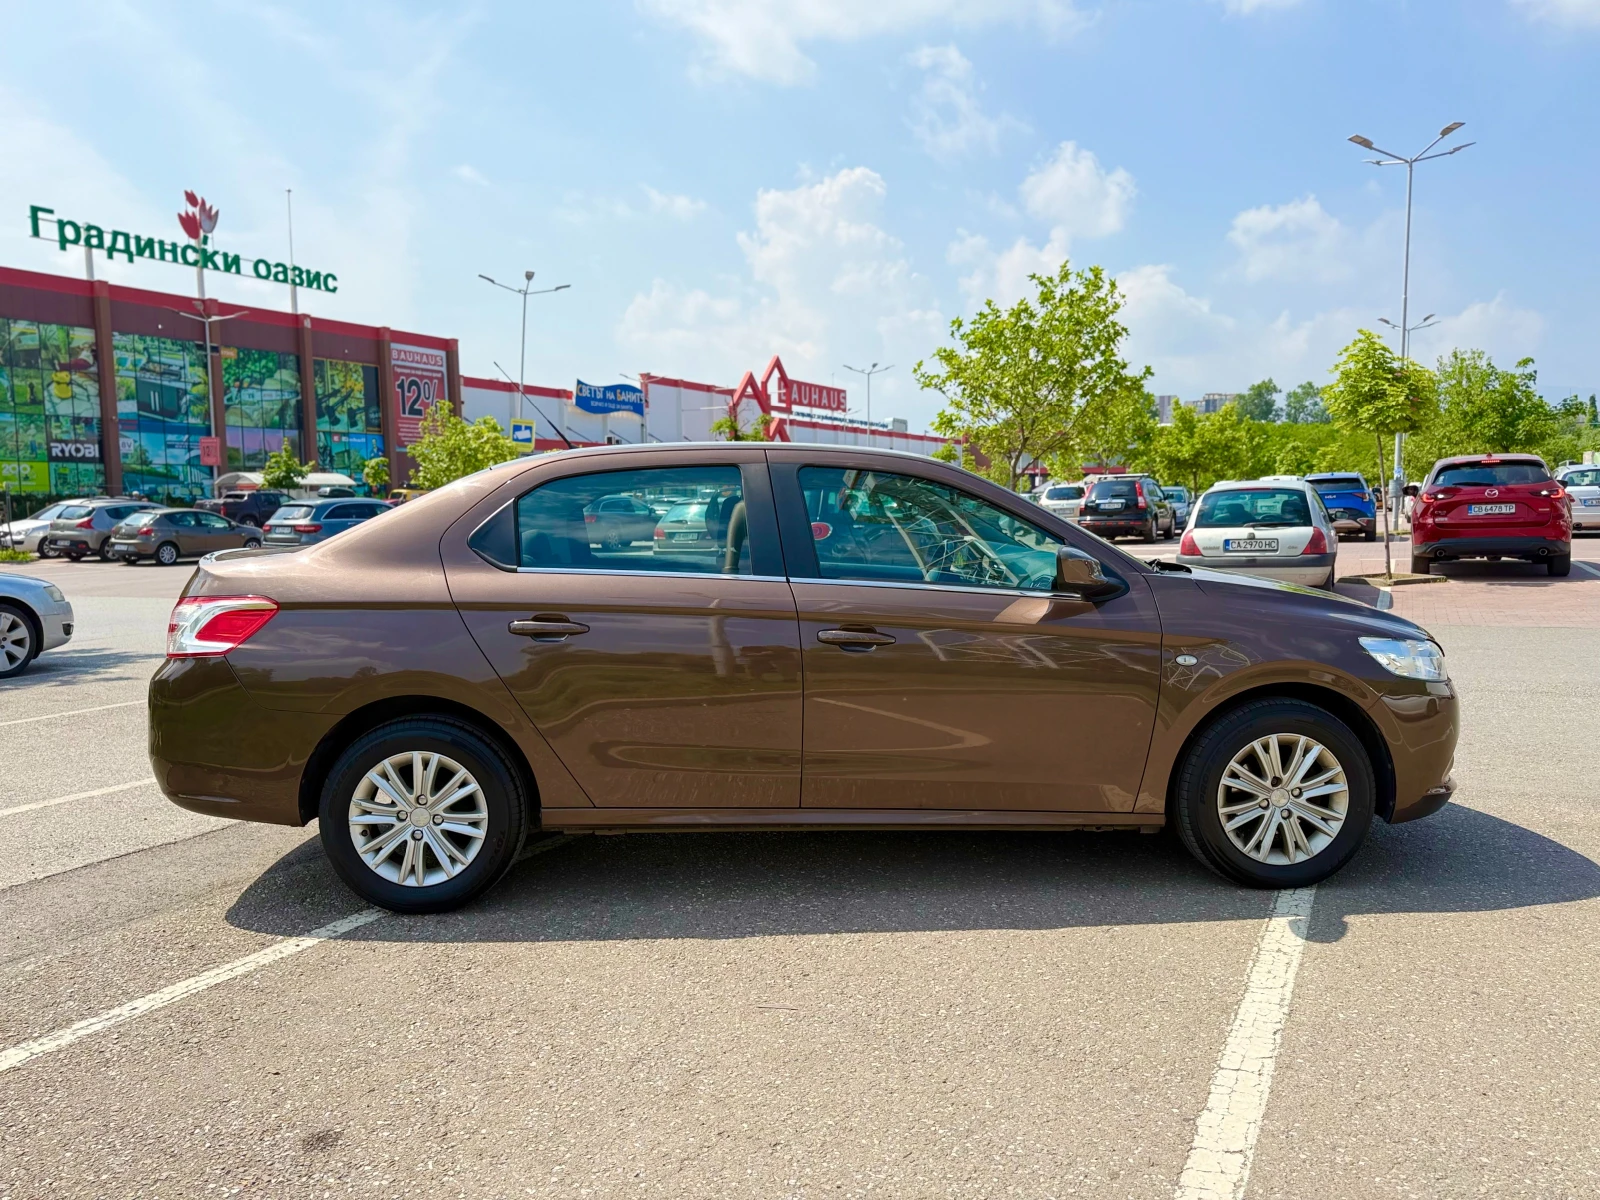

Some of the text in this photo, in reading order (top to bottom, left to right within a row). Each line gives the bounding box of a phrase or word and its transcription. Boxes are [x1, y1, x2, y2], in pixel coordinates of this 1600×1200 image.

[30, 205, 338, 294] Градински оазис
[391, 349, 443, 366] BAUHAUS
[50, 442, 100, 458] RYOBI
[1484, 505, 1502, 513] 6478
[1505, 504, 1514, 512] TP
[1230, 541, 1276, 549] CA 2970 HC
